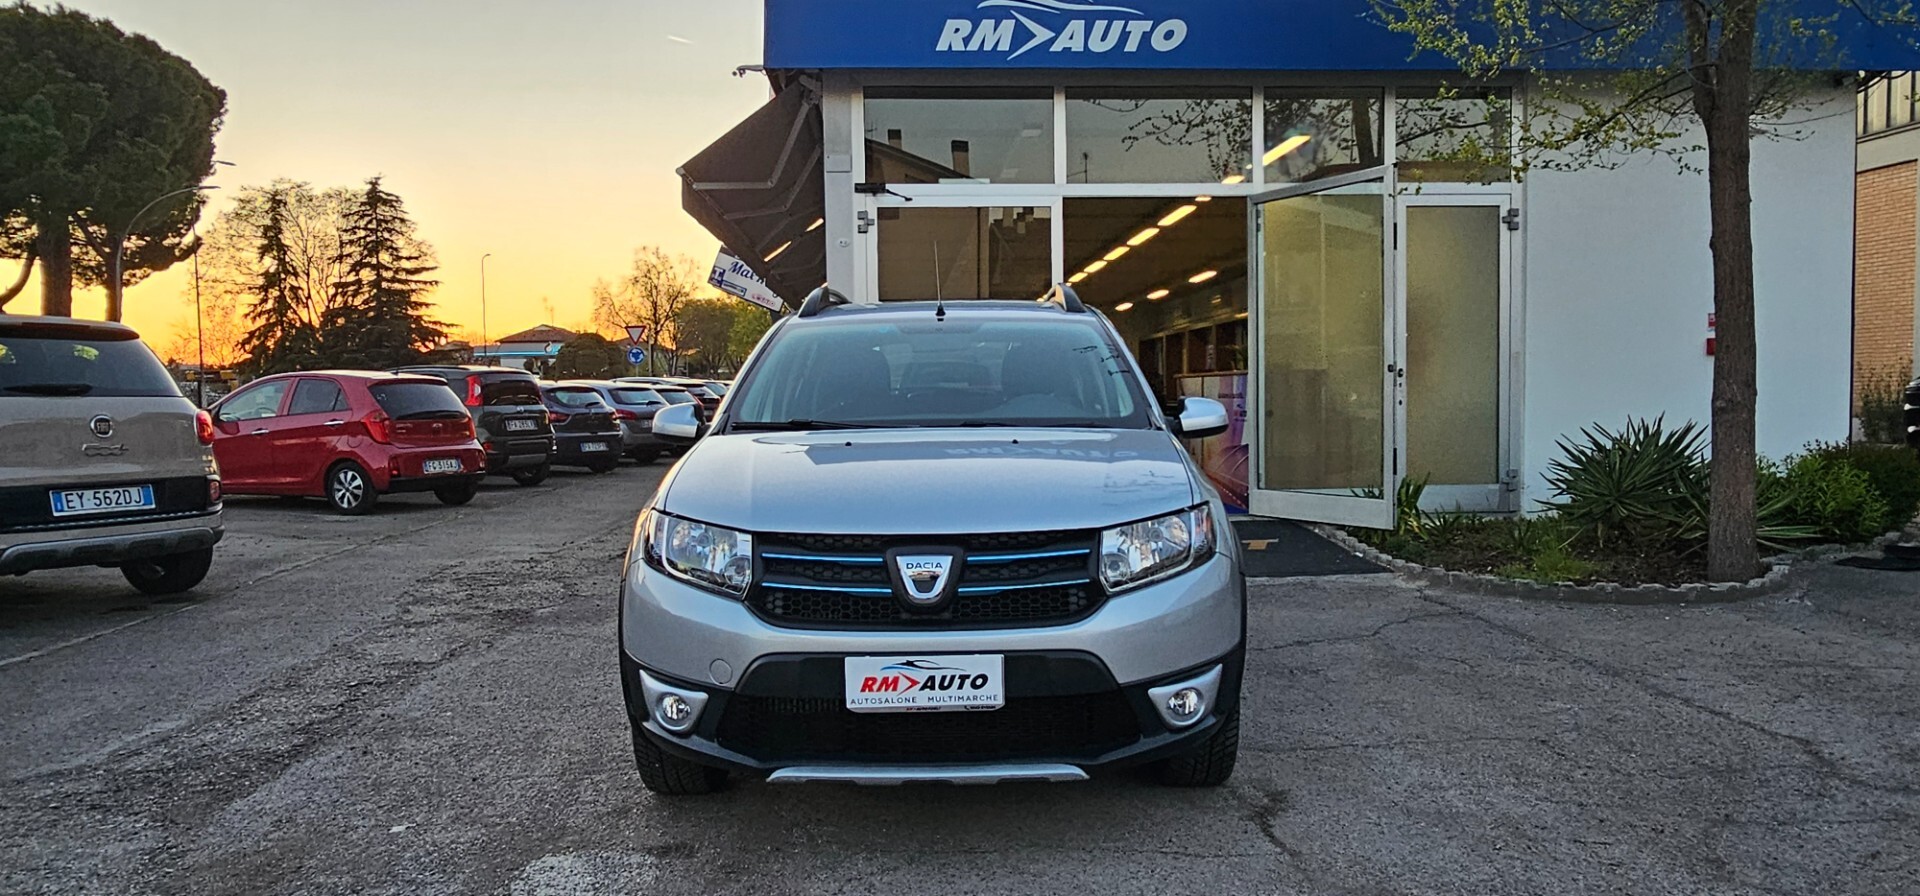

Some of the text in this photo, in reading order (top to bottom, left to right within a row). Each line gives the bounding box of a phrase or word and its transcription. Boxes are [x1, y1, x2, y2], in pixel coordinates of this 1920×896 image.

[935, 19, 1188, 52] RM AUTO
[64, 488, 143, 510] EY 562DJ
[905, 561, 943, 570] DACIA
[860, 673, 989, 693] RM AUTO
[850, 694, 999, 705] AUTOSALONE MULTIMARCHE
